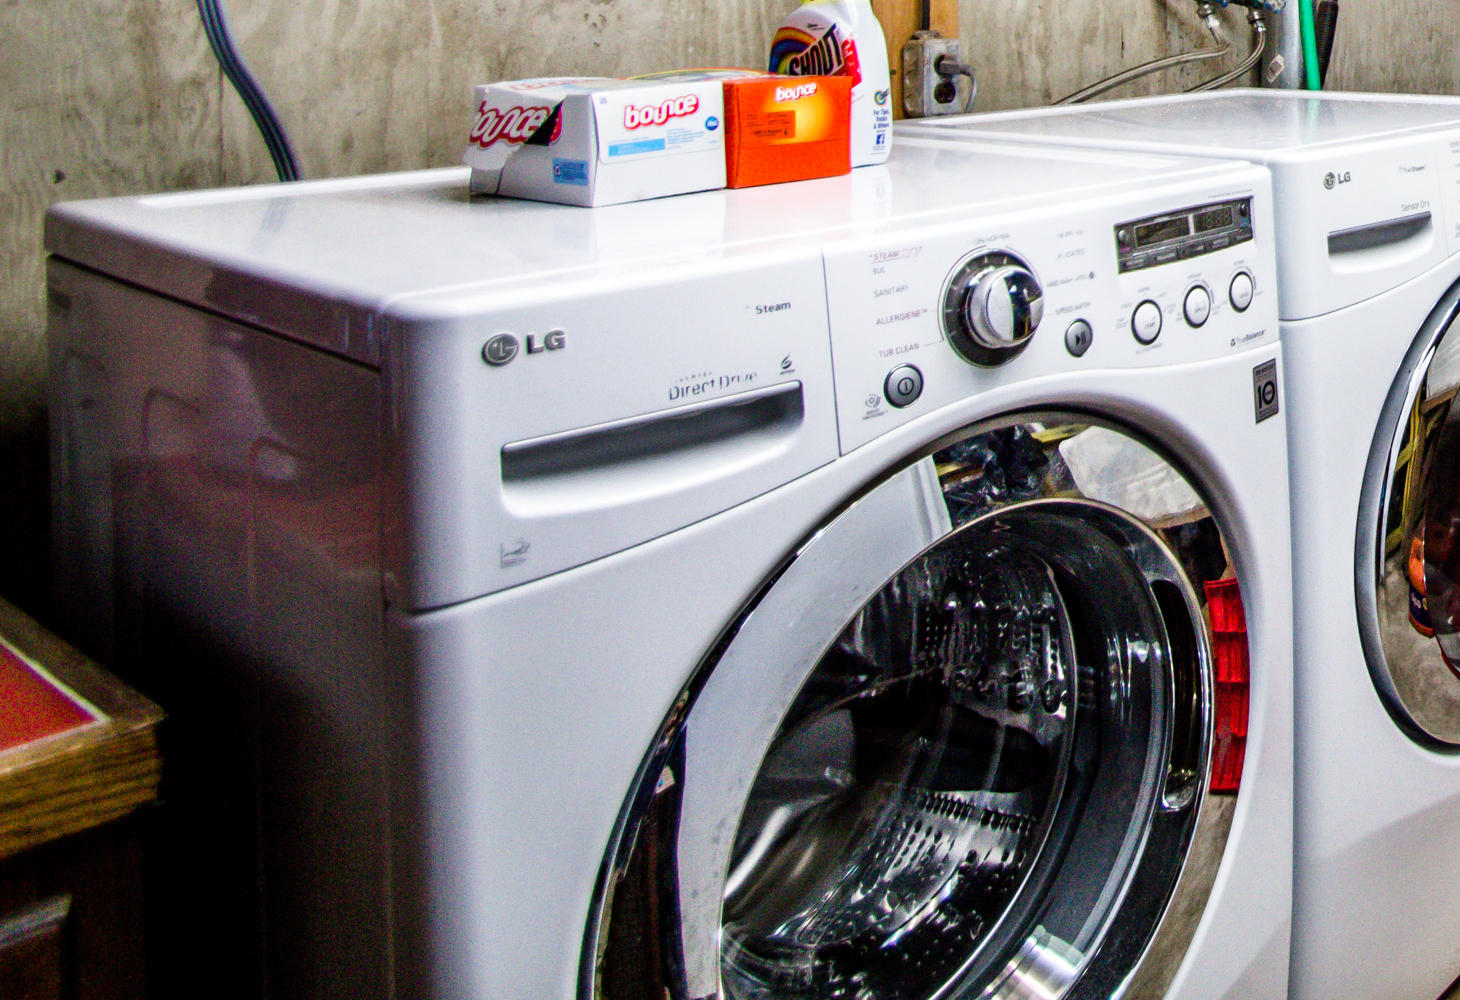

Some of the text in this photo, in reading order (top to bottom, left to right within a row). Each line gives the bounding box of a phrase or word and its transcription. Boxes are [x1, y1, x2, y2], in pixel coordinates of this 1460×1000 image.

[788, 22, 843, 76] SHOUT
[774, 82, 817, 103] bounce
[624, 94, 699, 130] bounce
[1337, 171, 1351, 185] LG
[755, 300, 792, 315] Steam
[526, 329, 567, 355] LG
[895, 342, 920, 356] CLEAN
[668, 378, 715, 400] Direct
[1257, 380, 1276, 410] 10
